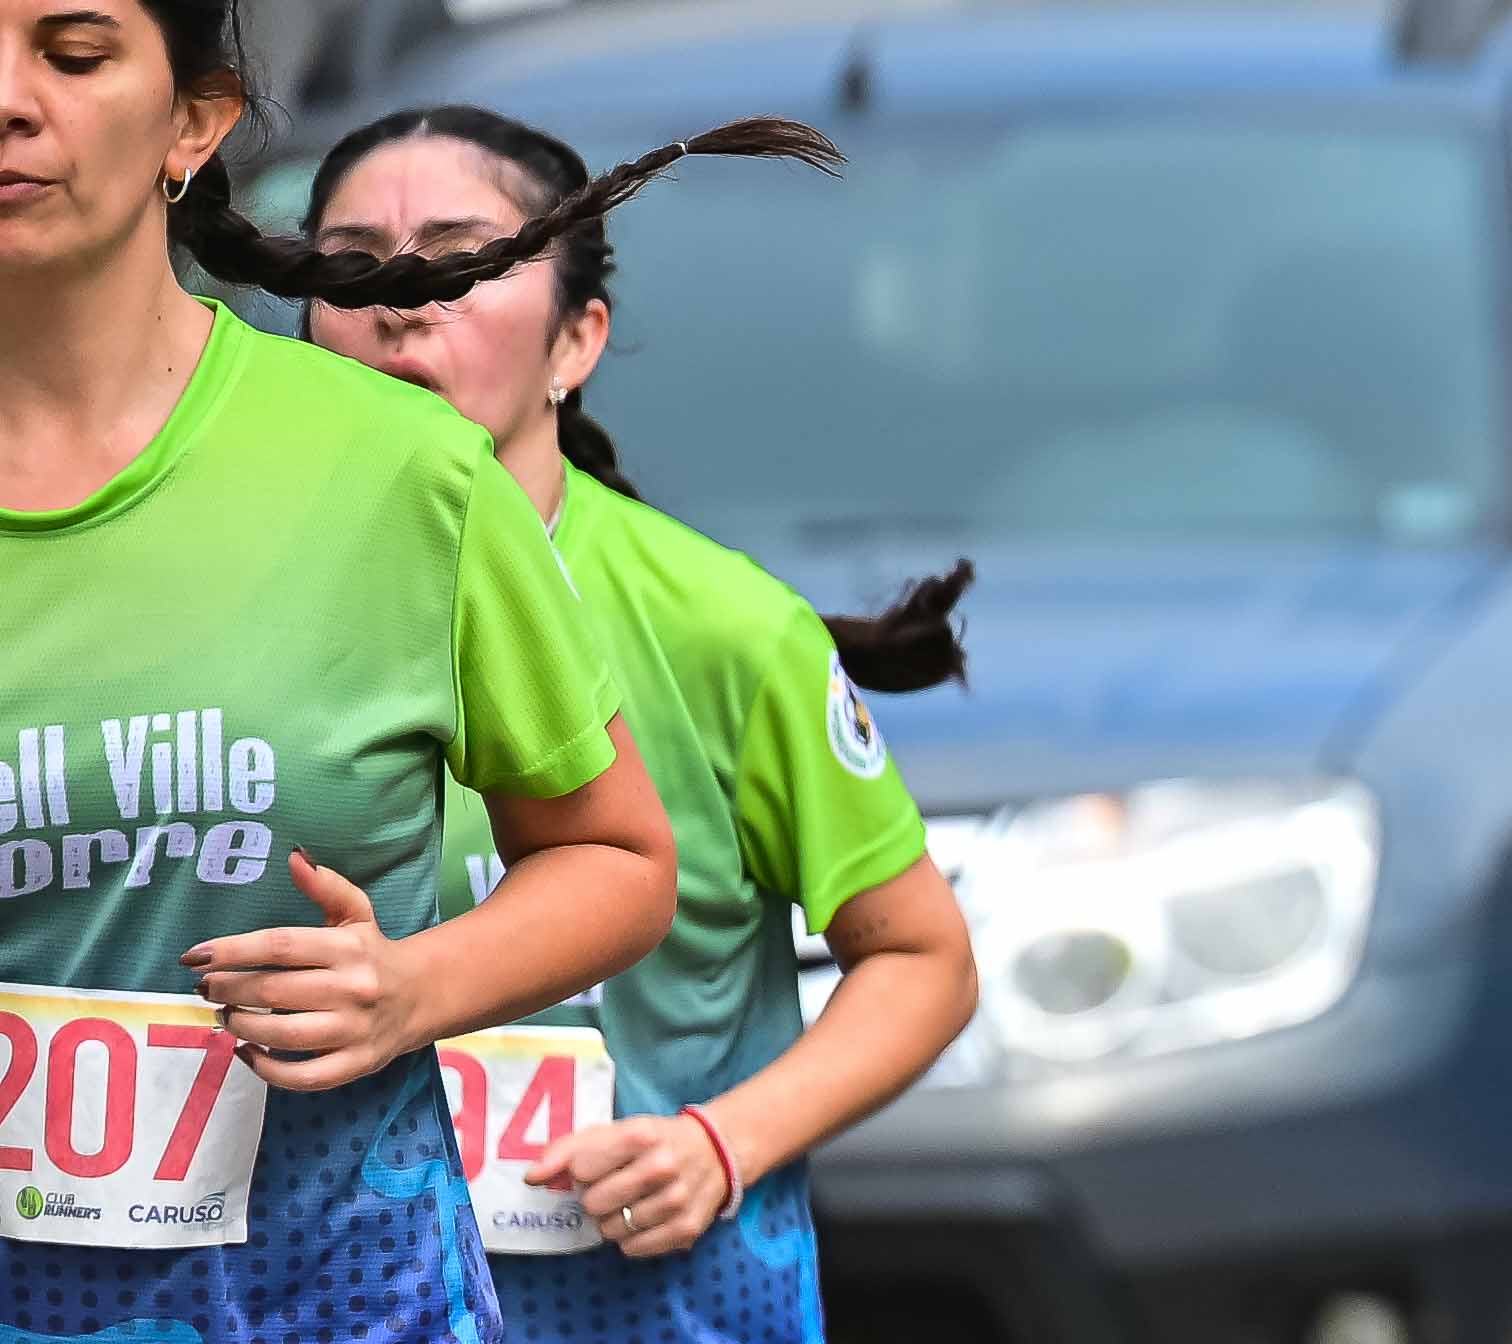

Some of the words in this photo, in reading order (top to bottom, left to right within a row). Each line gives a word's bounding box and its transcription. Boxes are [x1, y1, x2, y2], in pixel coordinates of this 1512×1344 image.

[101, 708, 274, 818] Ville
[128, 1204, 224, 1224] CARUSO
[492, 1210, 582, 1231] CARUSO
